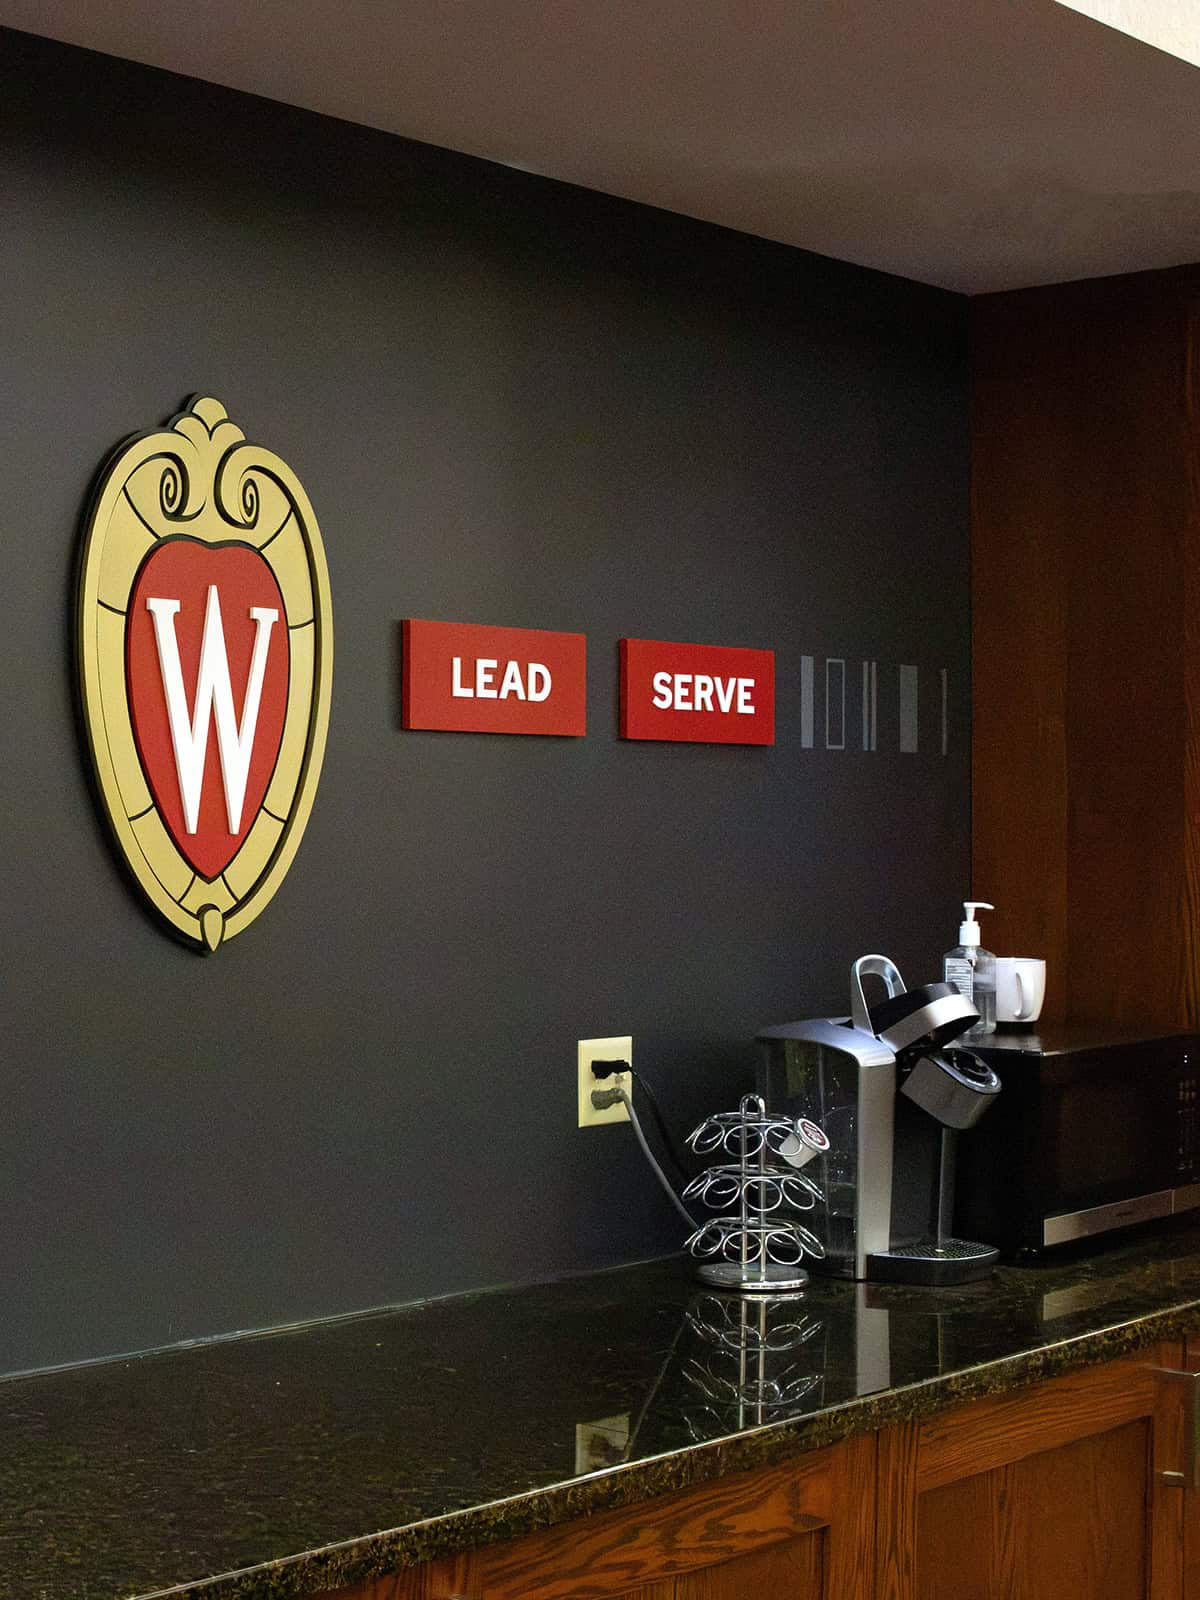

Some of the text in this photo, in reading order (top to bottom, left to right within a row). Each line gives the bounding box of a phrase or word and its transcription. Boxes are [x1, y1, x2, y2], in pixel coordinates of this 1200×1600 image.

[451, 656, 553, 703] LEAD
[652, 671, 756, 714] SERVE
[146, 583, 280, 835] W
